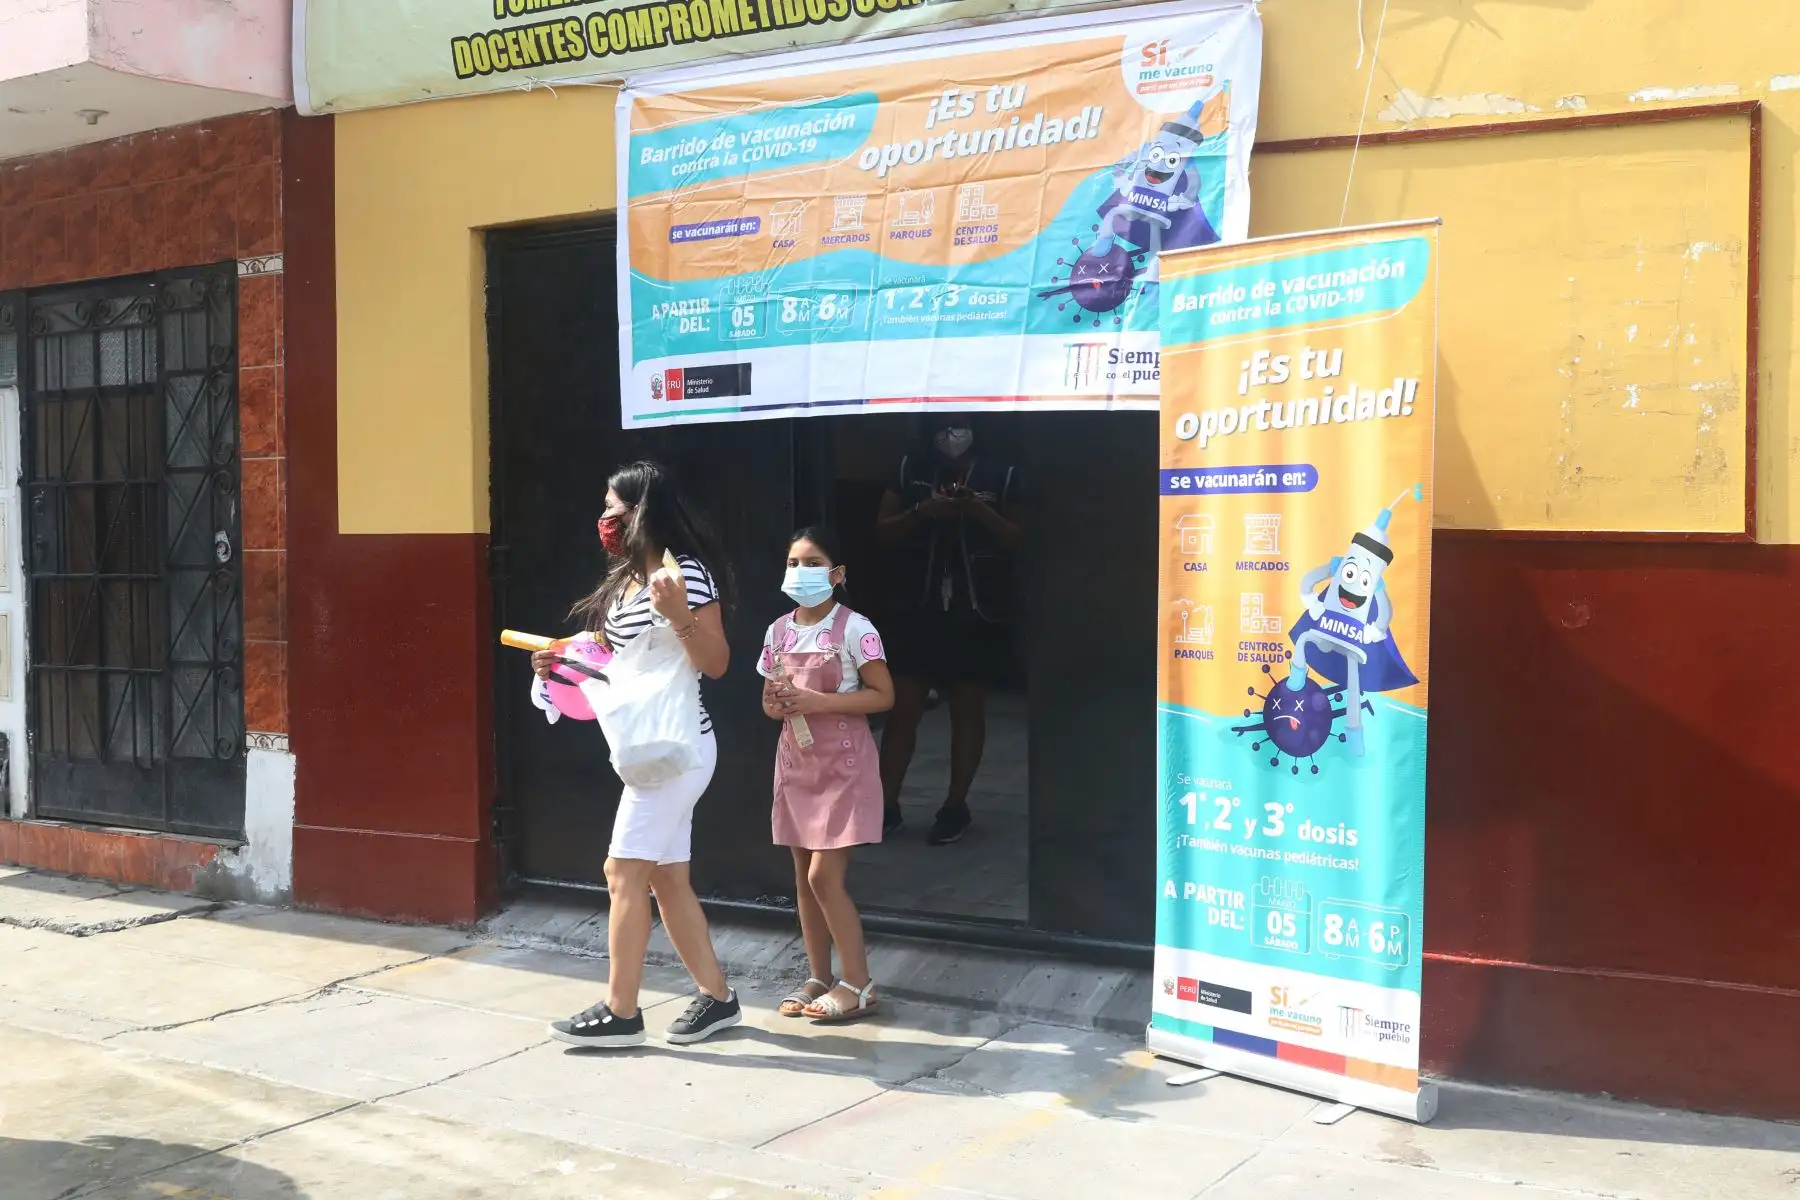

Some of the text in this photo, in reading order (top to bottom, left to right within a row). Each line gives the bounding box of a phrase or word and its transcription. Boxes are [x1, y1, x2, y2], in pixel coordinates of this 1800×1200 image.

[452, 15, 588, 79] DOCENTES
[1139, 63, 1214, 80] me vacuno
[925, 83, 1027, 130] ¡Es tu
[640, 112, 855, 165] Barrido de vacunación
[859, 105, 1103, 178] oportunidad!
[672, 138, 817, 176] contra la COVID-19
[1128, 191, 1168, 212] MINSA
[672, 221, 756, 240] se vacunarán en:
[821, 233, 870, 246] MERCADOS
[890, 228, 933, 240] PARQUES
[954, 234, 998, 246] DE SALUD
[956, 224, 998, 236] CENTROS
[772, 239, 795, 249] CASA
[1172, 257, 1406, 313] Barrido de vacunación
[968, 290, 1008, 305] dosis
[1210, 288, 1365, 325] contra la COVID-19
[652, 298, 710, 320] A PARTIR
[731, 305, 755, 328] 05
[782, 296, 798, 323] 8
[819, 294, 837, 321] 6
[679, 316, 711, 334] DEL:
[1238, 346, 1343, 396] ¡Es tu
[686, 377, 713, 386] Ministerio
[694, 386, 710, 394] Salud
[1175, 377, 1420, 450] oportunidad!
[1171, 469, 1307, 489] se vacunarán en:
[1184, 562, 1208, 572] CASA
[1235, 561, 1290, 572] MERCADOS
[1319, 616, 1365, 645] MINSA
[1174, 649, 1214, 661] PARQUES
[1238, 641, 1284, 652] CENTROS
[1237, 652, 1284, 664] DE SALUD
[1176, 773, 1191, 785] Se
[1244, 817, 1257, 840] y
[1297, 819, 1359, 847] dosis
[1176, 834, 1359, 871] ¡También vacunas pediátricas!
[1163, 880, 1245, 910] A PARTIR
[1208, 909, 1244, 931] DEL:
[1267, 911, 1296, 937] 05
[1324, 914, 1344, 945] 8
[1368, 921, 1386, 954] 6
[1270, 1006, 1322, 1025] me vacuno
[1365, 1014, 1411, 1033] Siempre
[1379, 1032, 1411, 1044] pueblo
